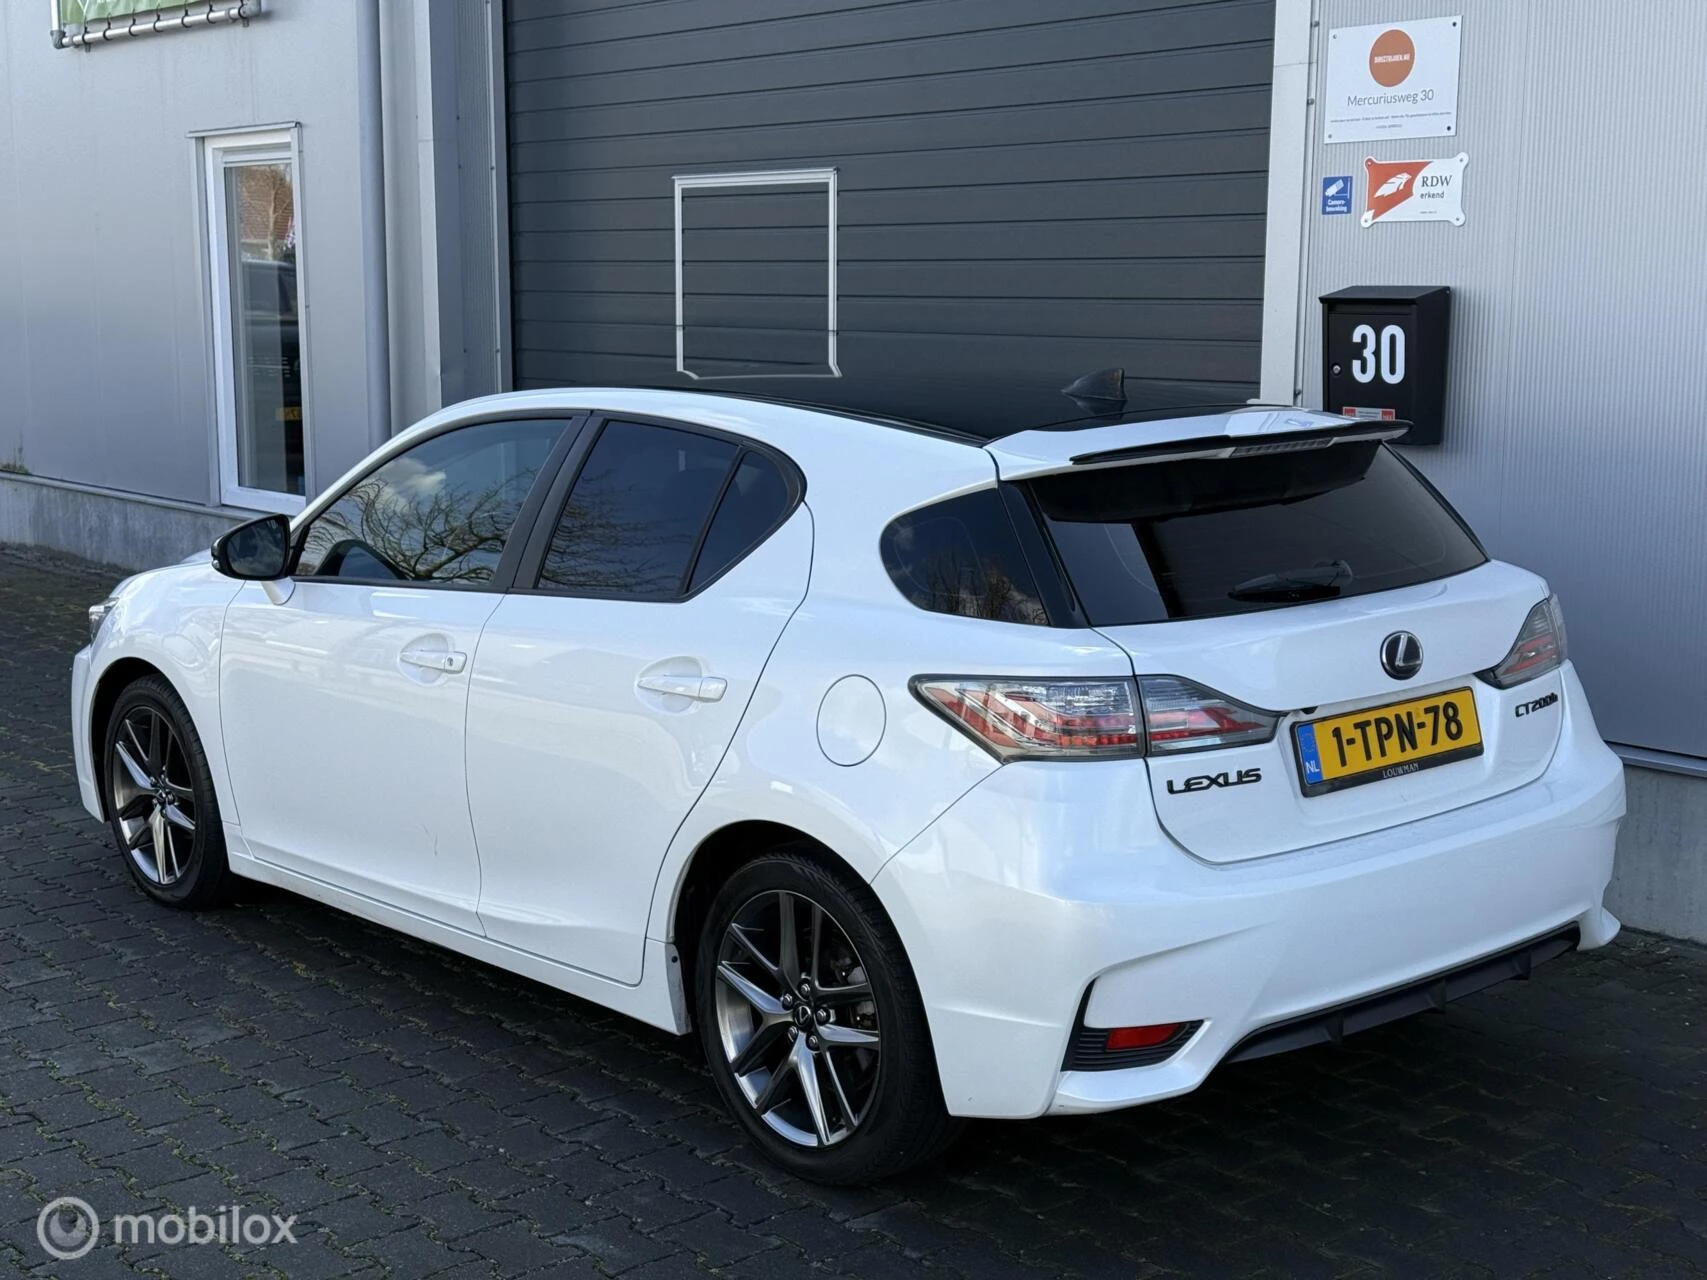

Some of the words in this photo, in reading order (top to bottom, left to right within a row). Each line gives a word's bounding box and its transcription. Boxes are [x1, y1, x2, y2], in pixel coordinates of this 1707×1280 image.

[1347, 92, 1418, 107] Mercuriusweg
[1420, 89, 1435, 102] 30
[1421, 174, 1453, 187] RDW
[1420, 190, 1445, 199] erkend
[1352, 324, 1406, 385] 30
[1515, 692, 1559, 718] CT200h
[1332, 701, 1463, 768] 1-TPN-78
[1305, 760, 1320, 774] NL
[1382, 763, 1419, 779] LOUWMAN
[1166, 767, 1262, 795] LEXUS
